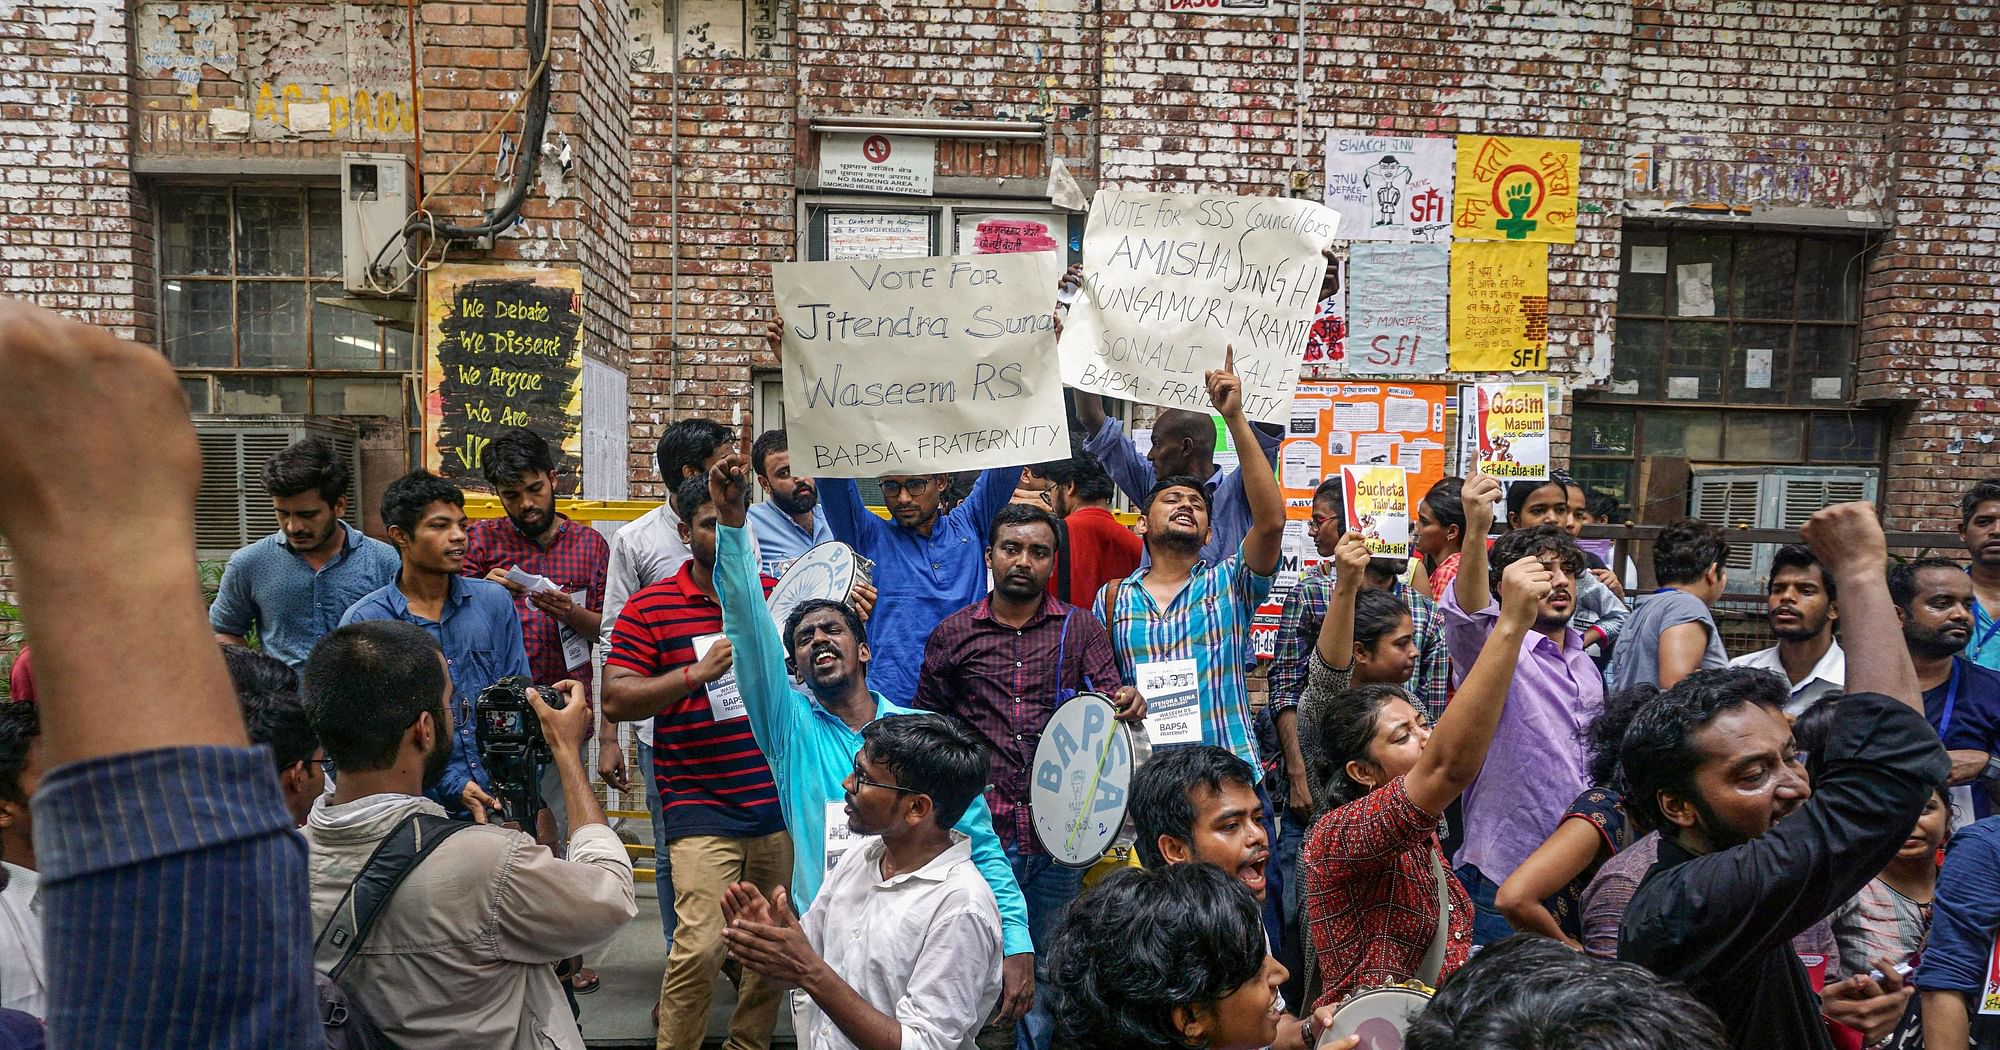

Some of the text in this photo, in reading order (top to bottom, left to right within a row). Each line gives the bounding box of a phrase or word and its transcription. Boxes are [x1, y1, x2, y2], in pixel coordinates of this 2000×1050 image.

[1339, 139, 1413, 151] SWACCH JNU
[823, 181, 855, 189] SMOKING
[1332, 173, 1358, 184] JNU
[1344, 193, 1368, 204] MENT
[1410, 193, 1444, 222] SFI
[1101, 193, 1331, 238] VOTE FOR SSS Councillors
[850, 263, 936, 291] VOTE
[1107, 227, 1318, 310] AMISHA SINGH
[463, 298, 549, 322] We Debate
[1076, 271, 1233, 329] MUNGAMURI
[794, 303, 1055, 342] Jitendra Suna
[1377, 315, 1429, 328] MONSTERS
[460, 330, 561, 356] We Dissent
[1094, 329, 1294, 392] SONALI KALE
[1511, 349, 1540, 367] SFI
[458, 364, 543, 397] We Argue
[799, 362, 1023, 409] Waseem RS
[1080, 364, 1140, 392] BAPSA
[465, 400, 529, 427] We Are
[1491, 392, 1544, 415] Qasim
[1504, 417, 1545, 430] Masumi
[1357, 480, 1405, 497] Sucheta
[1150, 693, 1196, 709] JITENDRA SUNA
[1160, 709, 1184, 718] WASEEM
[1160, 722, 1188, 731] BAPSA
[1036, 703, 1127, 814] BAPSA
[1098, 822, 1108, 836] 2
